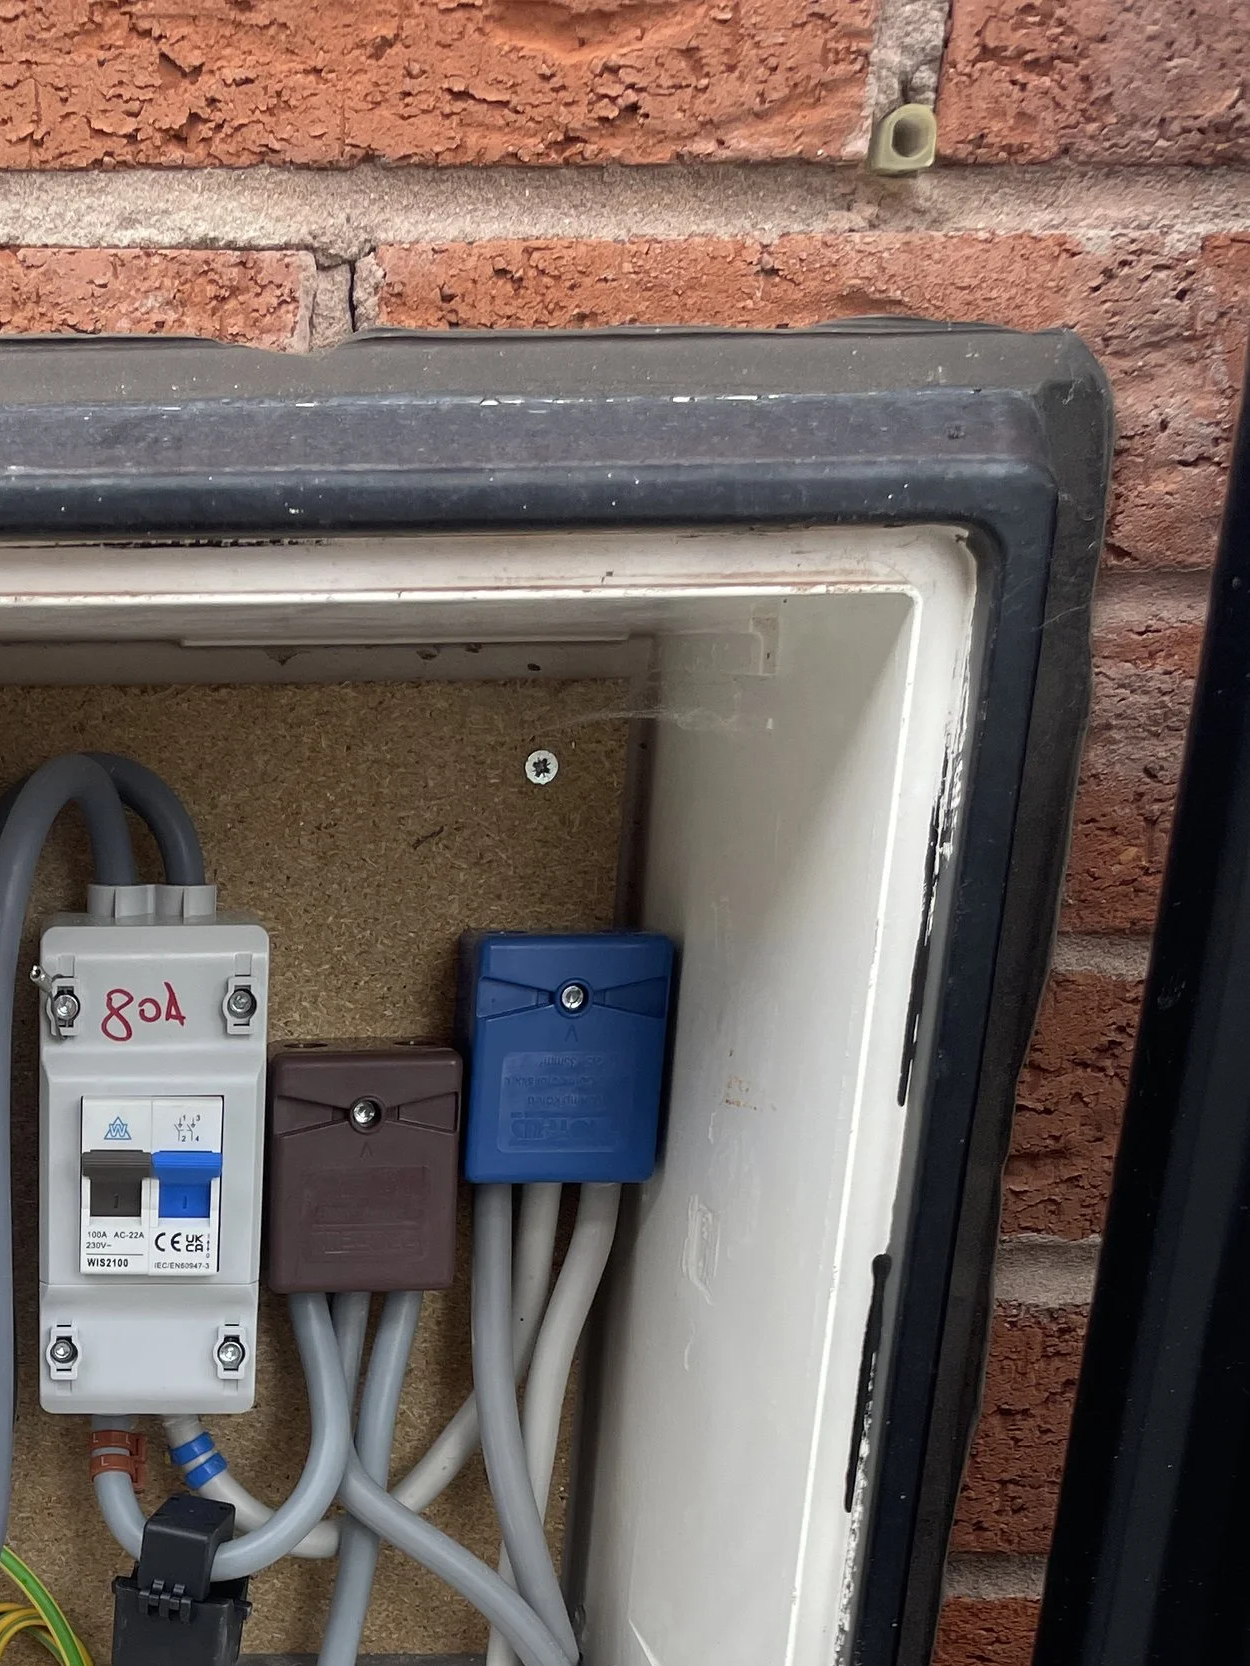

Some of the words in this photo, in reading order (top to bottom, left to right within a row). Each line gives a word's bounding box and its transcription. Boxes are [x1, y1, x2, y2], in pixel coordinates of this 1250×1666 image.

[101, 980, 186, 1042] 80A
[87, 1231, 108, 1239] 100A
[113, 1231, 145, 1239] AC-22A
[87, 1258, 129, 1268] WIS2100
[154, 1261, 210, 1270] IEC/EN60947-3
